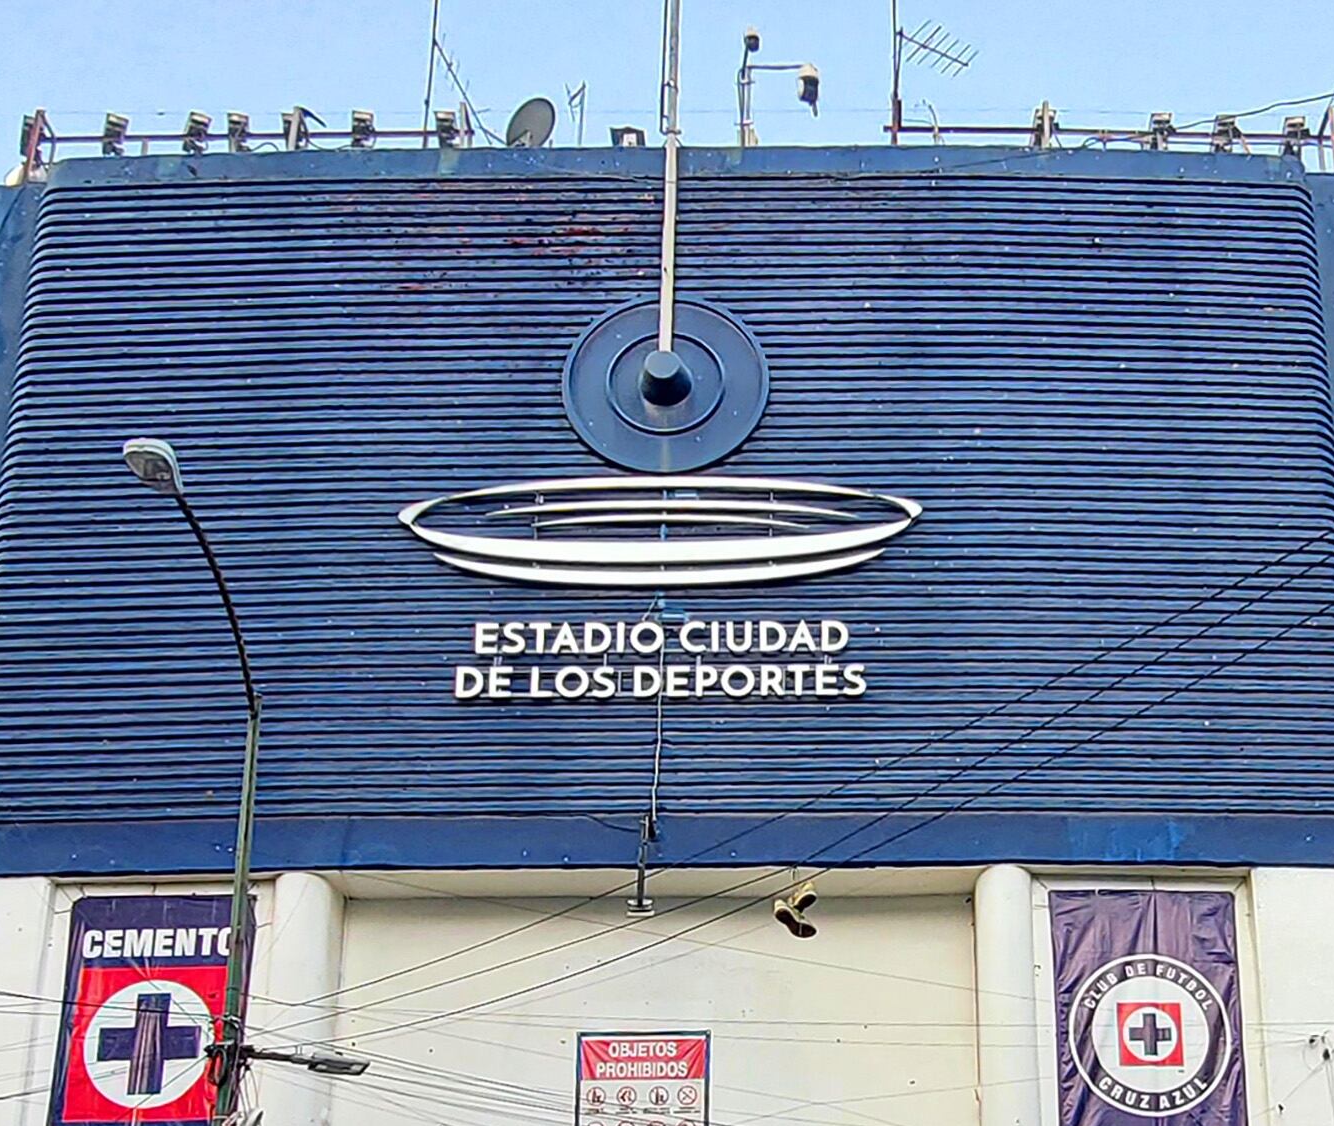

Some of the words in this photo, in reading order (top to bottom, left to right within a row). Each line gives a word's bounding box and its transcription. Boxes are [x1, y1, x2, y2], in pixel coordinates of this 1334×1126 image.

[473, 621, 665, 656] ESTADIO
[679, 619, 850, 655] CIUDAD
[454, 665, 522, 699] DE
[529, 665, 616, 699] LOS
[632, 663, 867, 698] DEPORTES
[1084, 972, 1118, 1009] CLUB
[1124, 963, 1146, 977] DE
[1155, 964, 1213, 1011] FUTBOL
[607, 1041, 678, 1058] OBJETOS
[595, 1061, 689, 1079] PROHIBIDOS
[1098, 1076, 1151, 1109] CRUZ
[1158, 1077, 1208, 1110] AZUL
